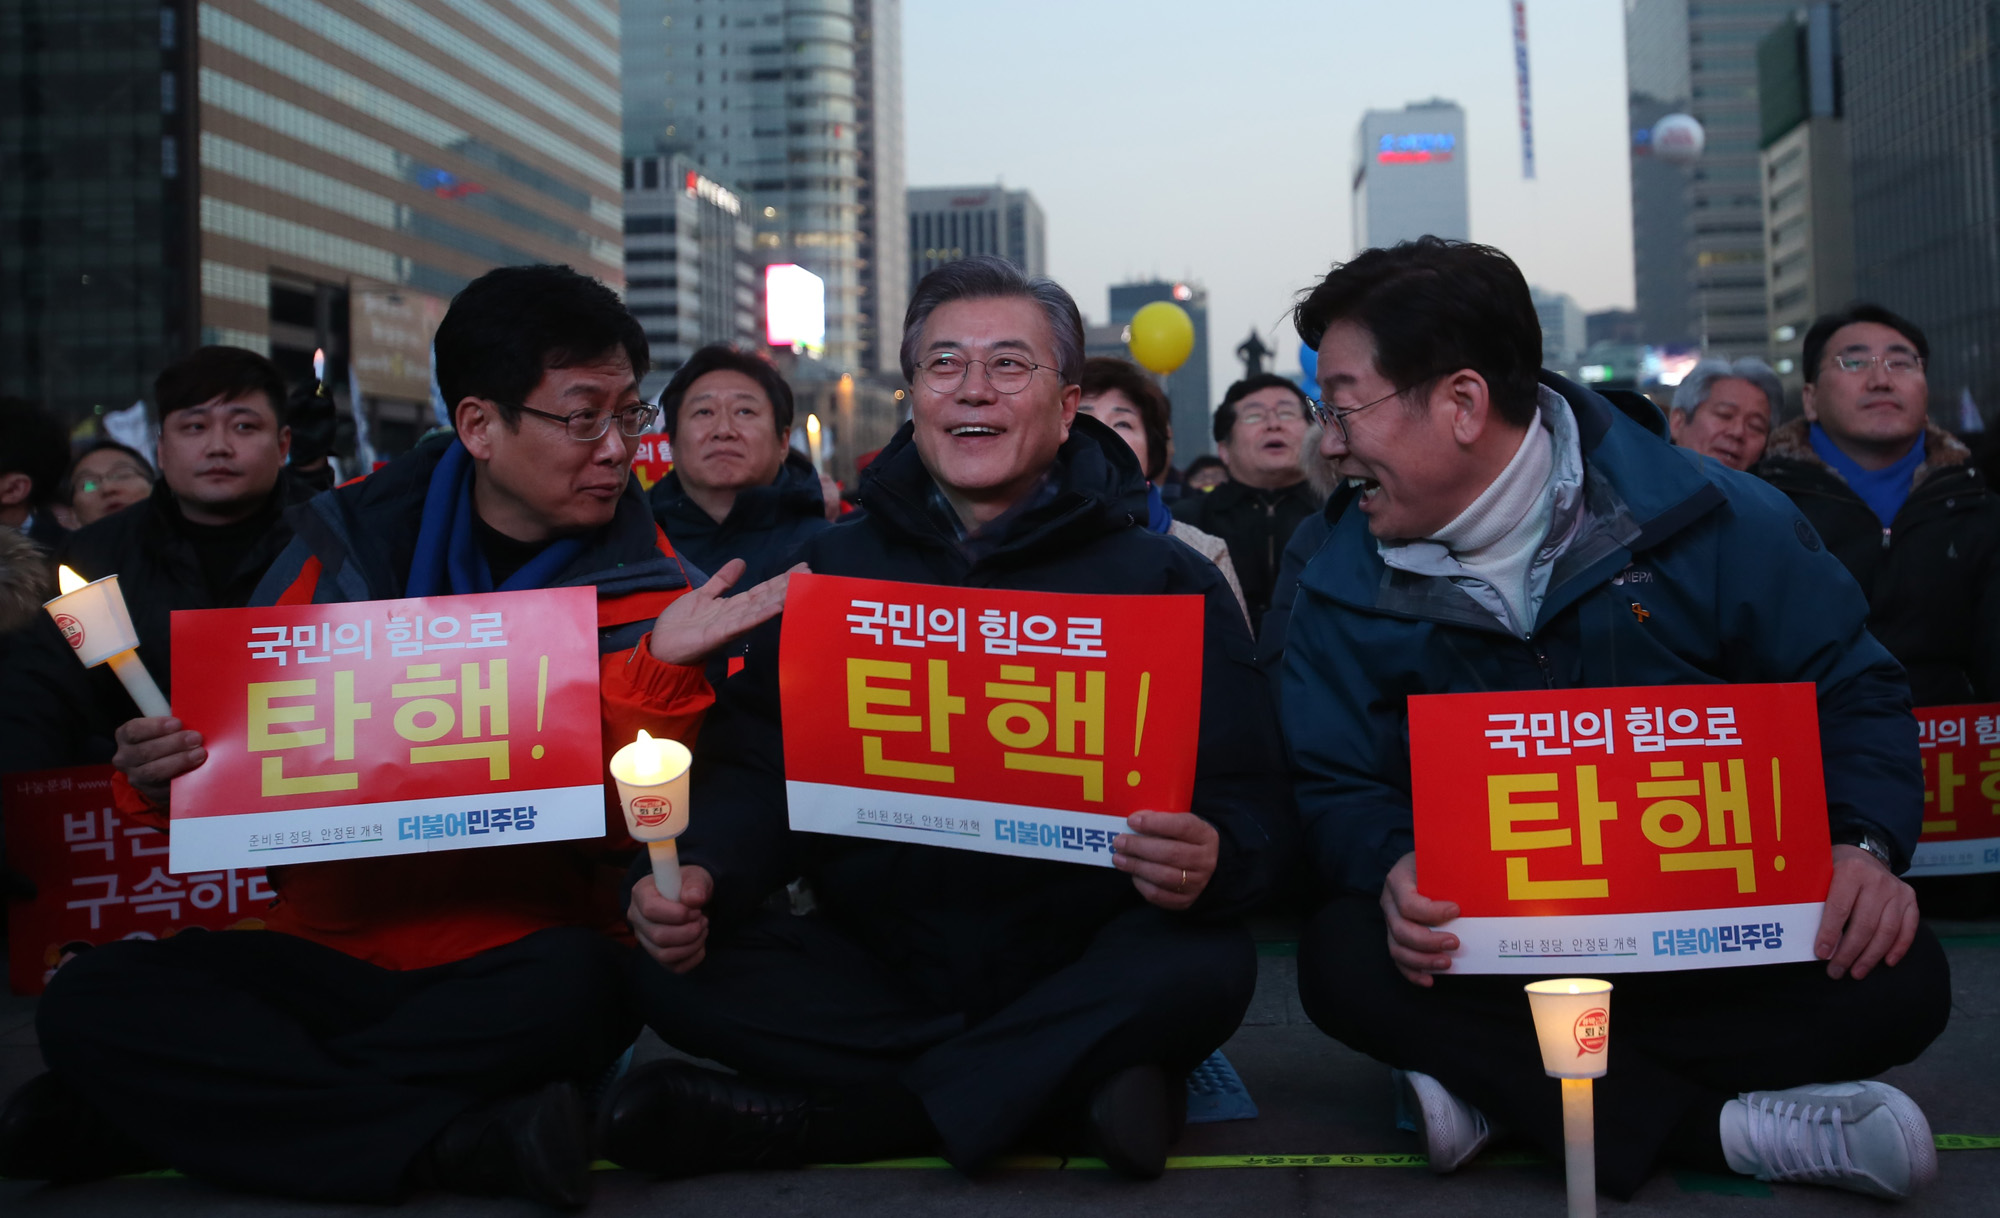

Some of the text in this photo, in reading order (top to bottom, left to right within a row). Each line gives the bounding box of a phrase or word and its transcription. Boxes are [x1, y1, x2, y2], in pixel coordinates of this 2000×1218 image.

[1624, 571, 1653, 583] NEPA
[247, 612, 507, 666] 국민의 힘으로
[847, 599, 1107, 657] 국민의 힘으로
[247, 655, 549, 797] 탄핵!
[846, 657, 1151, 803] 탄핵!
[1484, 706, 1743, 758] 국민의 힘으로
[1921, 748, 2000, 833] 탄
[248, 832, 284, 847] 준비된
[320, 826, 355, 841] 안정된
[360, 823, 383, 837] 개혁
[398, 805, 538, 841] 더불어민주당
[857, 808, 888, 822] 준비된
[921, 815, 954, 829] 안정된
[960, 819, 980, 832] 개혁
[1487, 757, 1786, 900] 탄핵!
[1498, 939, 1534, 953] 준비된
[1572, 937, 1608, 952] 안정된
[1614, 936, 1637, 950] 개혁
[1653, 922, 1784, 956] 더불어민주당
